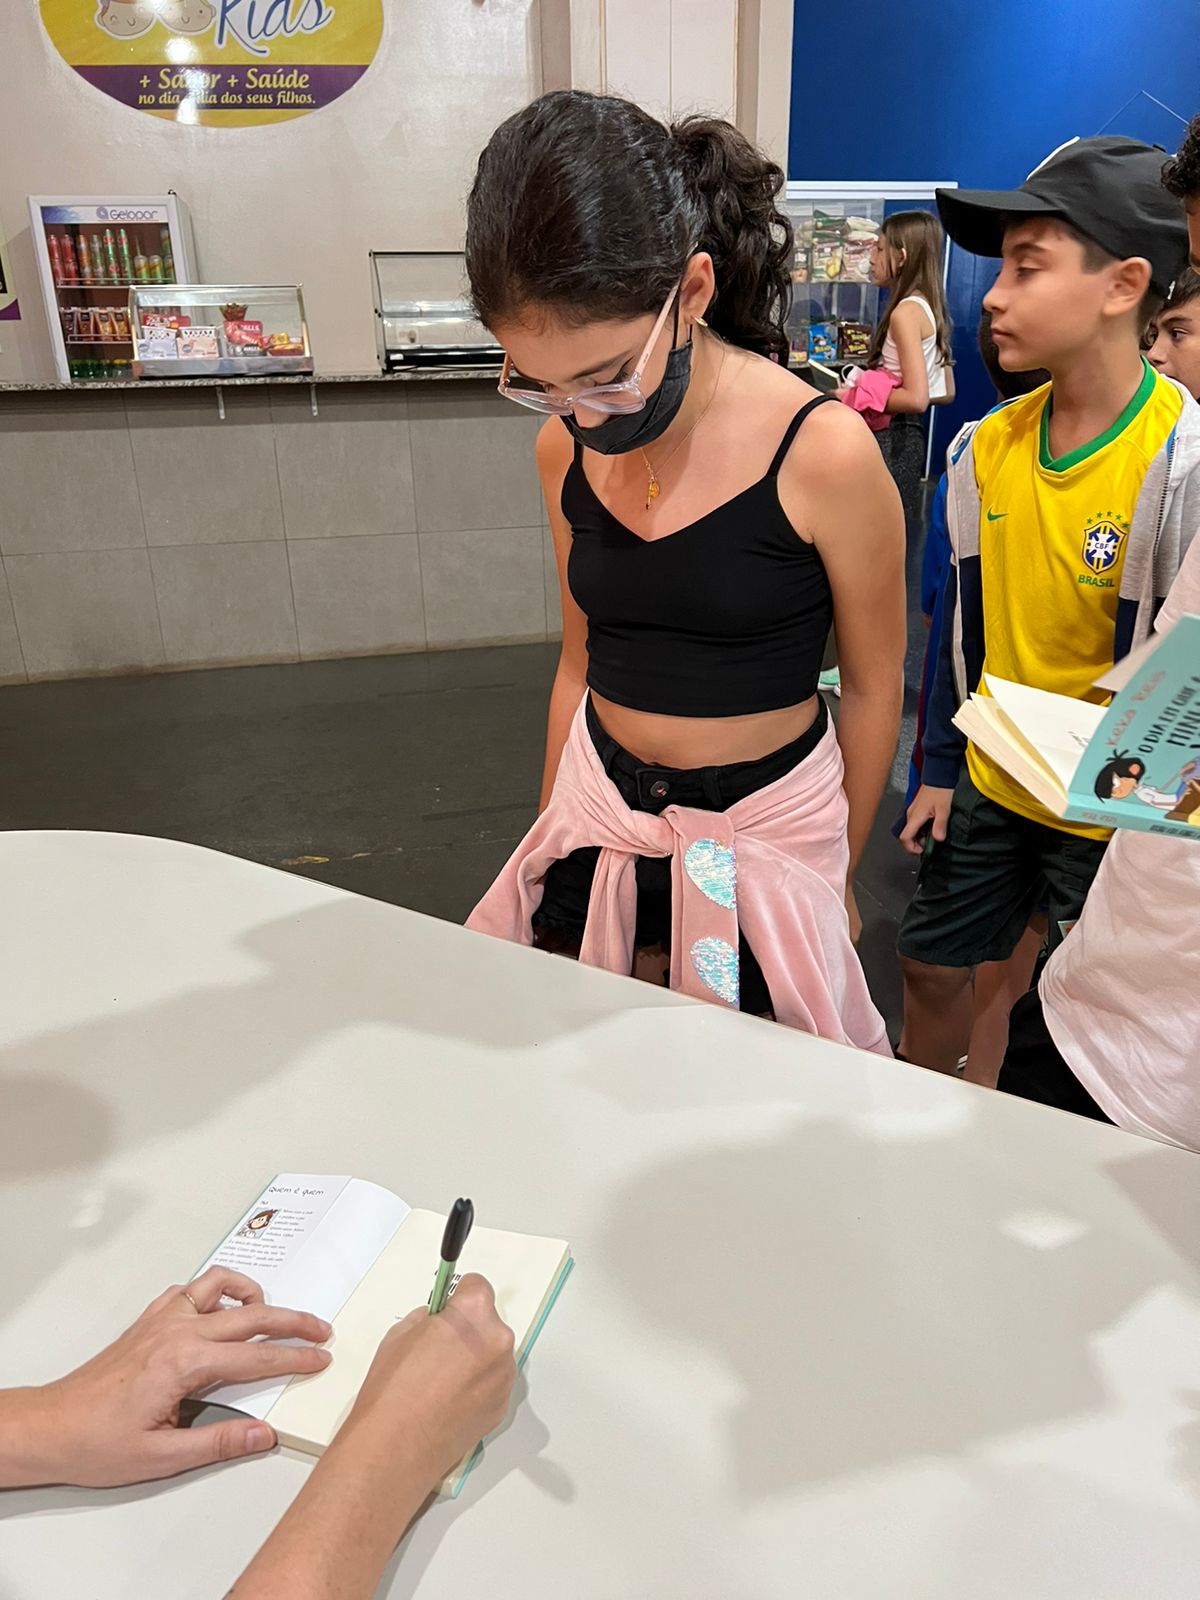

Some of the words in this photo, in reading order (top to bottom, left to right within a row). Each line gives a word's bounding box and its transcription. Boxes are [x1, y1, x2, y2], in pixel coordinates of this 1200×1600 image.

[140, 75, 150, 88] +
[158, 68, 221, 89] Saor
[228, 74, 239, 88] +
[245, 68, 310, 90] Saúde
[138, 94, 155, 104] no
[159, 92, 180, 104] dia
[221, 92, 243, 104] dos
[247, 94, 273, 105] seus
[276, 91, 316, 106] filhos.
[110, 209, 158, 220] Gelopar
[1094, 542, 1110, 550] CBF
[1078, 574, 1115, 587] BRASIL
[1143, 724, 1168, 743] DIA
[1138, 744, 1154, 753] O
[302, 1188, 324, 1197] quem
